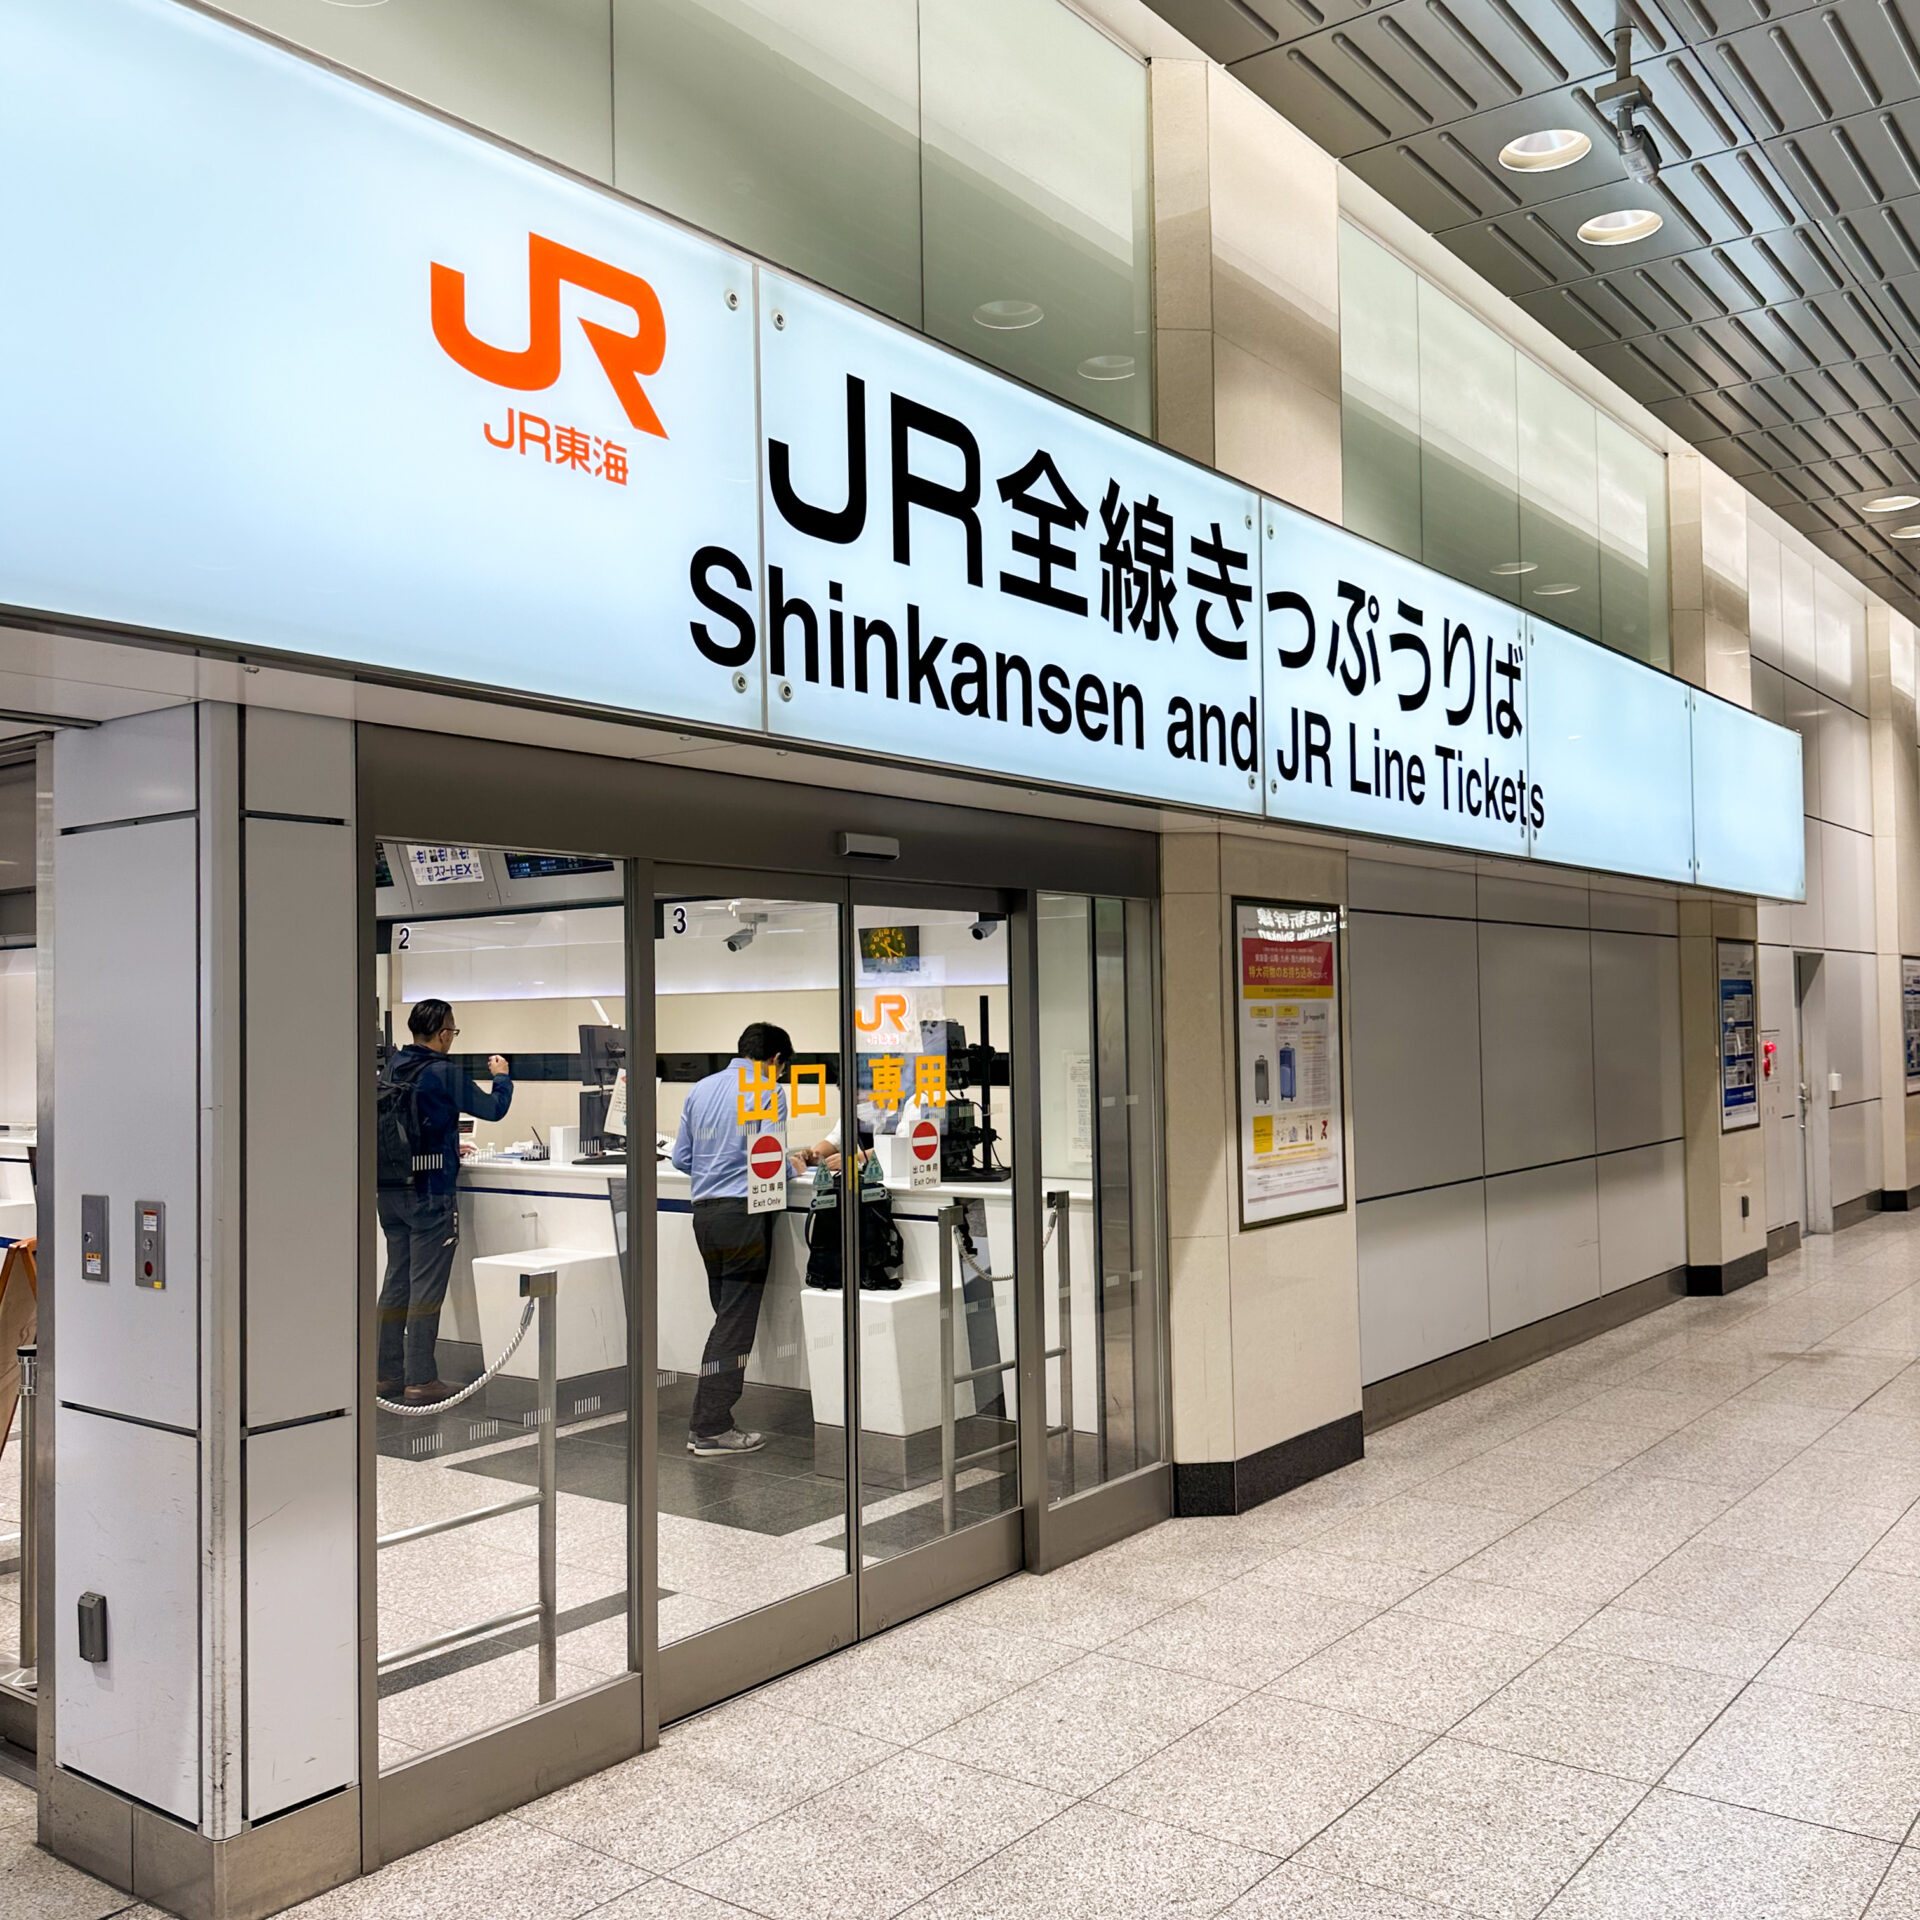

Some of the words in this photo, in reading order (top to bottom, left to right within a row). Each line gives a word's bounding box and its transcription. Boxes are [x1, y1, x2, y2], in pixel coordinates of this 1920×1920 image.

[431, 231, 669, 440] JR
[484, 407, 628, 486] JR東海
[768, 373, 1524, 739] JR全線きっぷうりば
[690, 546, 1145, 750] Shinkansen
[1167, 696, 1259, 773] and
[1277, 707, 1333, 788] JR
[1349, 722, 1426, 806] Line
[1435, 744, 1544, 829] Tickets
[433, 863, 473, 877] スマートEX
[673, 907, 687, 934] 3
[399, 927, 410, 950] 2
[855, 994, 910, 1032] JR
[737, 1060, 827, 1126] 出口
[868, 1054, 947, 1112] 専用
[912, 1163, 938, 1174] 出口専用
[752, 1181, 784, 1194] 出口専用
[753, 1199, 766, 1208] Exit
[767, 1197, 781, 1206] Only
